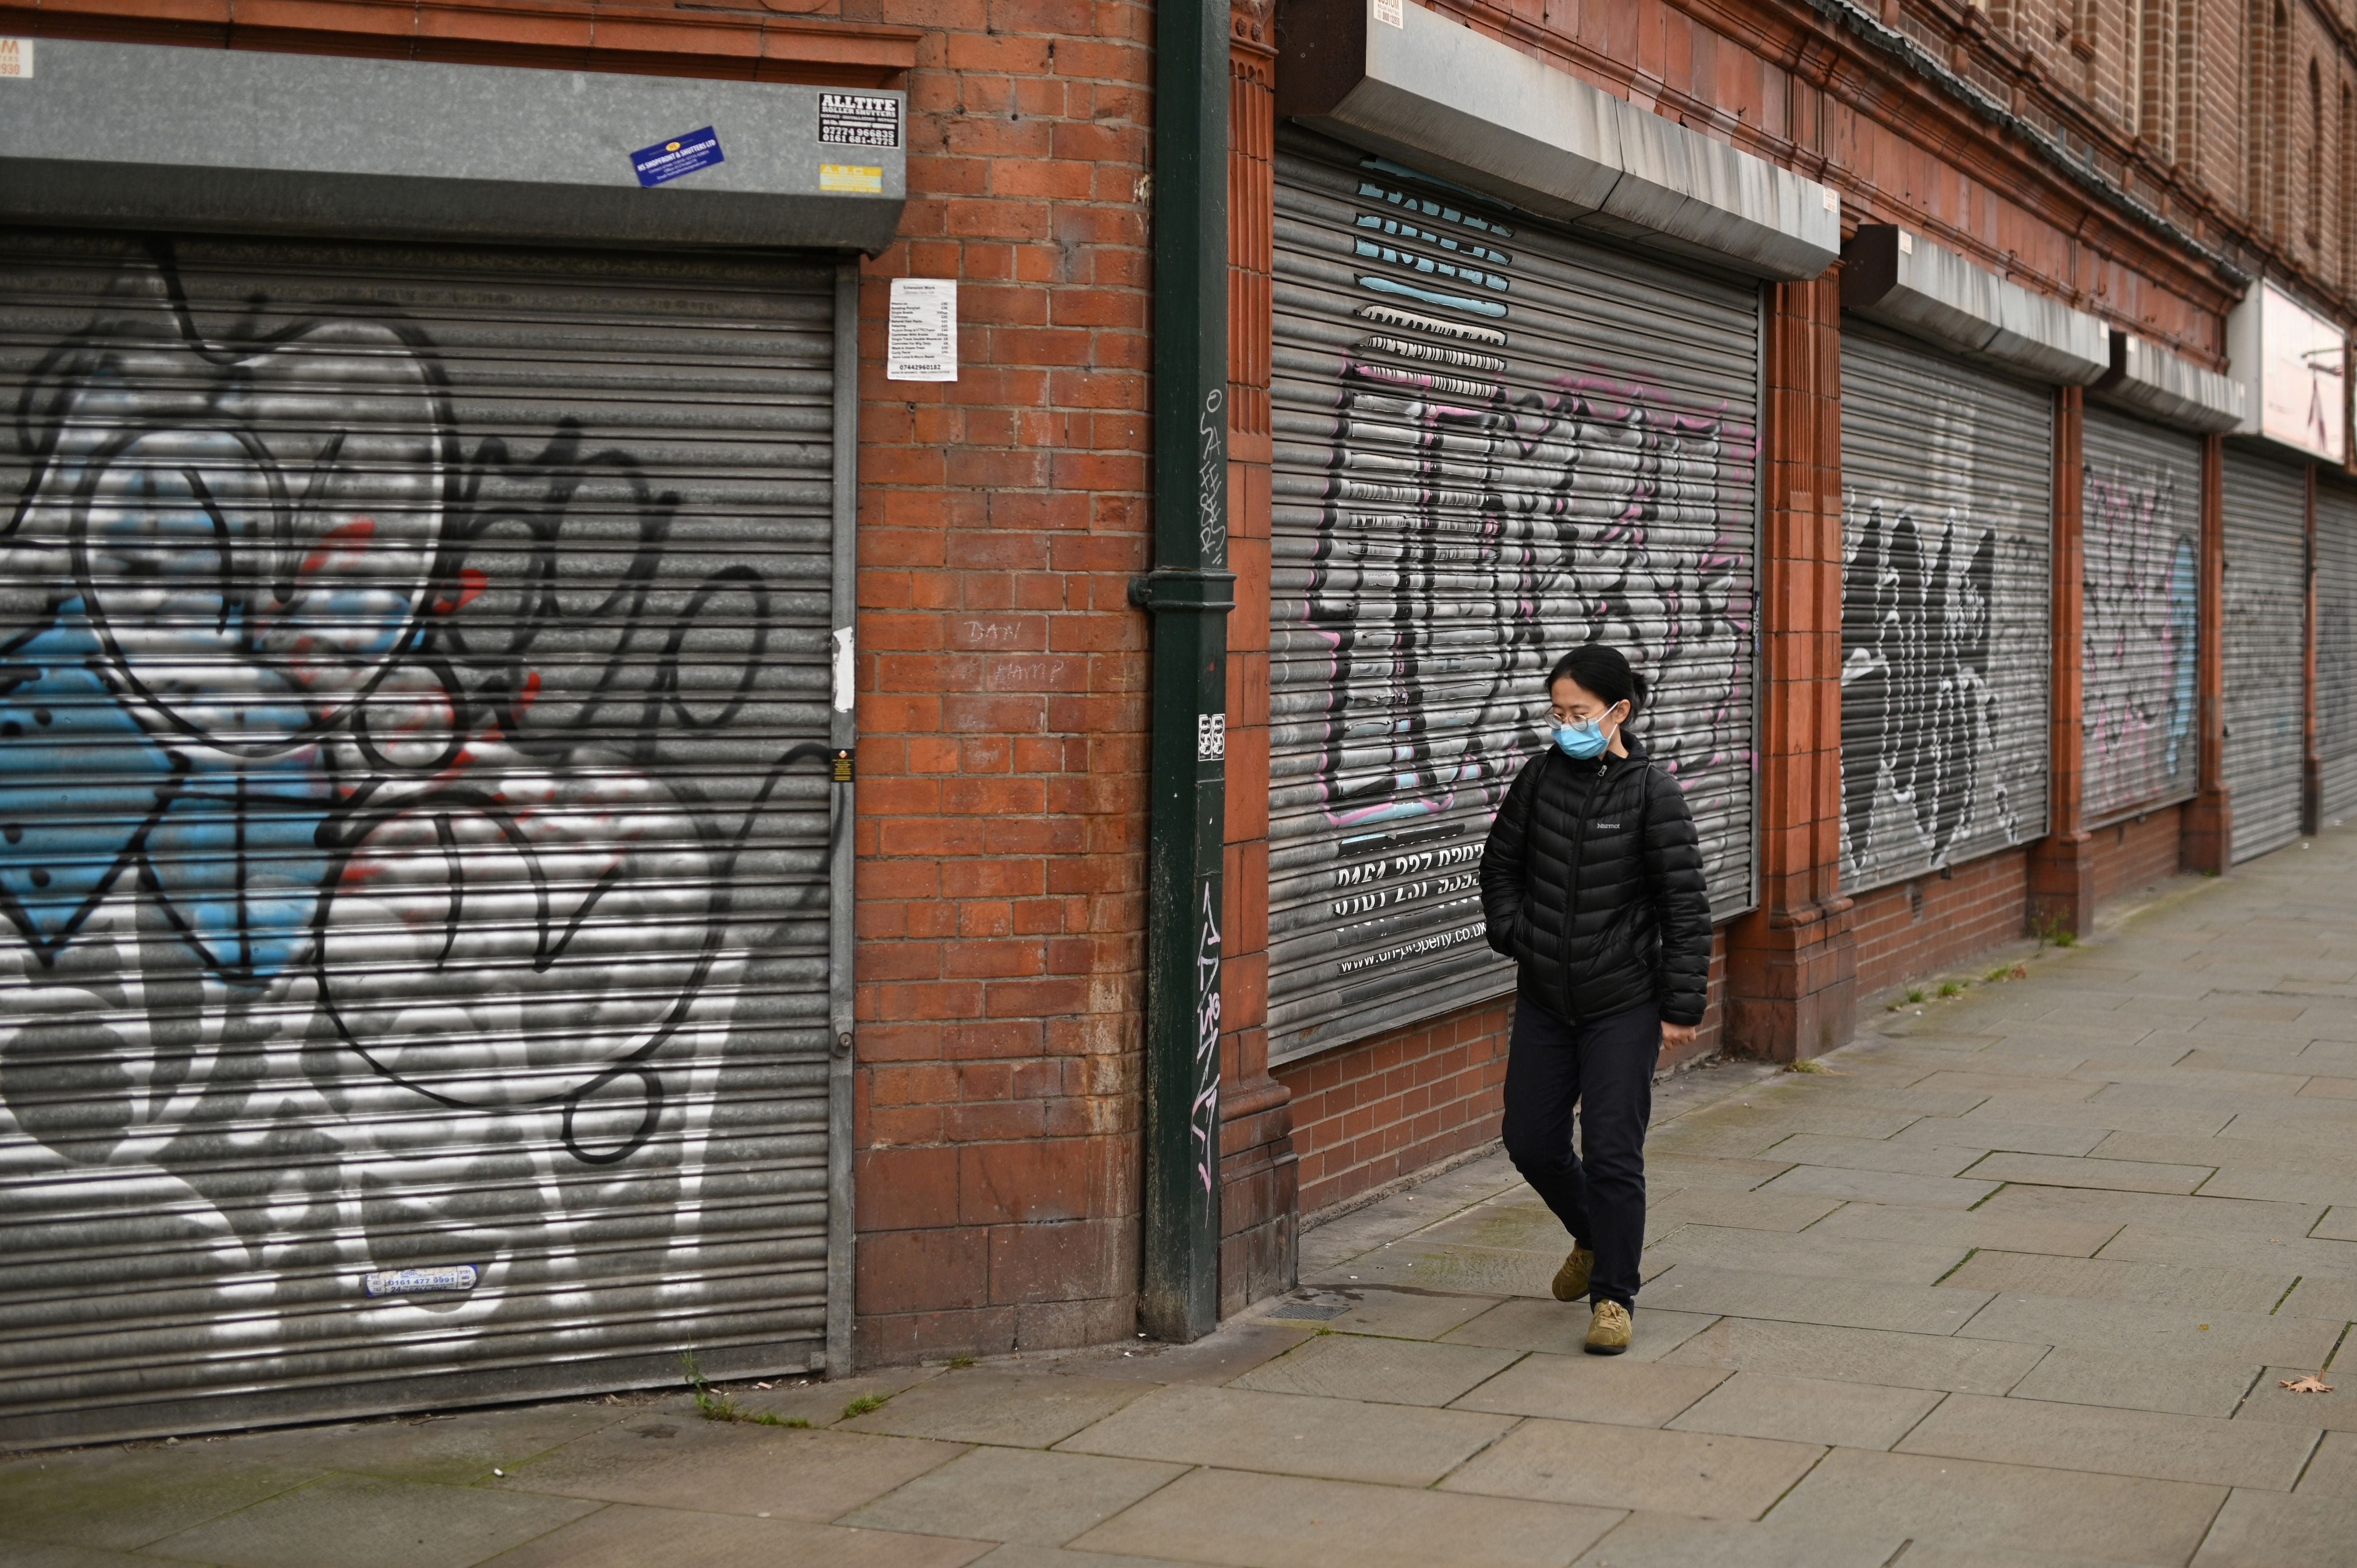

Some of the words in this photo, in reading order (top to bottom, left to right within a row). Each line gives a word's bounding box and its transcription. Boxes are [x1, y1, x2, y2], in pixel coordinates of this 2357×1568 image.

[0, 64, 20, 75] 930
[822, 94, 896, 111] ALLTITE
[822, 106, 854, 115] ROLLER
[855, 109, 896, 117] SHUTTERS
[823, 126, 855, 136] 07774
[856, 128, 895, 139] 966835
[823, 134, 847, 143] 0161
[848, 135, 895, 146] 681-6775
[645, 152, 676, 169] SHOPFRONT
[680, 142, 707, 157] SHUTTERS
[706, 139, 717, 148] LTD
